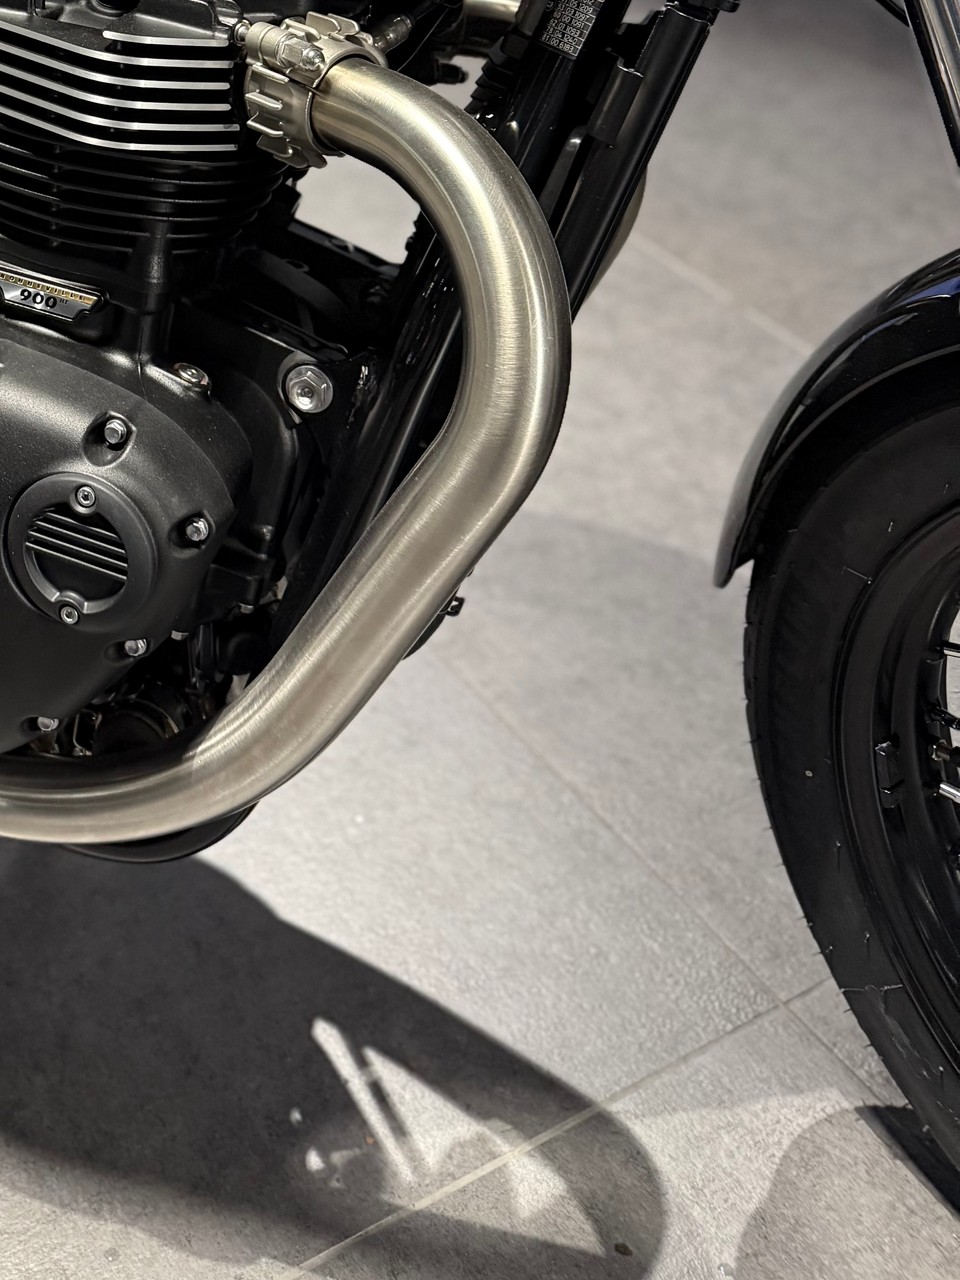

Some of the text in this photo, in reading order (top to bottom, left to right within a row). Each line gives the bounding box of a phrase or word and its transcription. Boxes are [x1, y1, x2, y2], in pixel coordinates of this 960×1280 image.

[577, 3, 592, 14] 1209
[562, 14, 570, 23] 00
[574, 10, 589, 22] 1097
[558, 22, 565, 30] 01
[550, 37, 559, 45] 00
[0, 272, 85, 302] BONNEVILLE
[20, 288, 58, 309] 900
